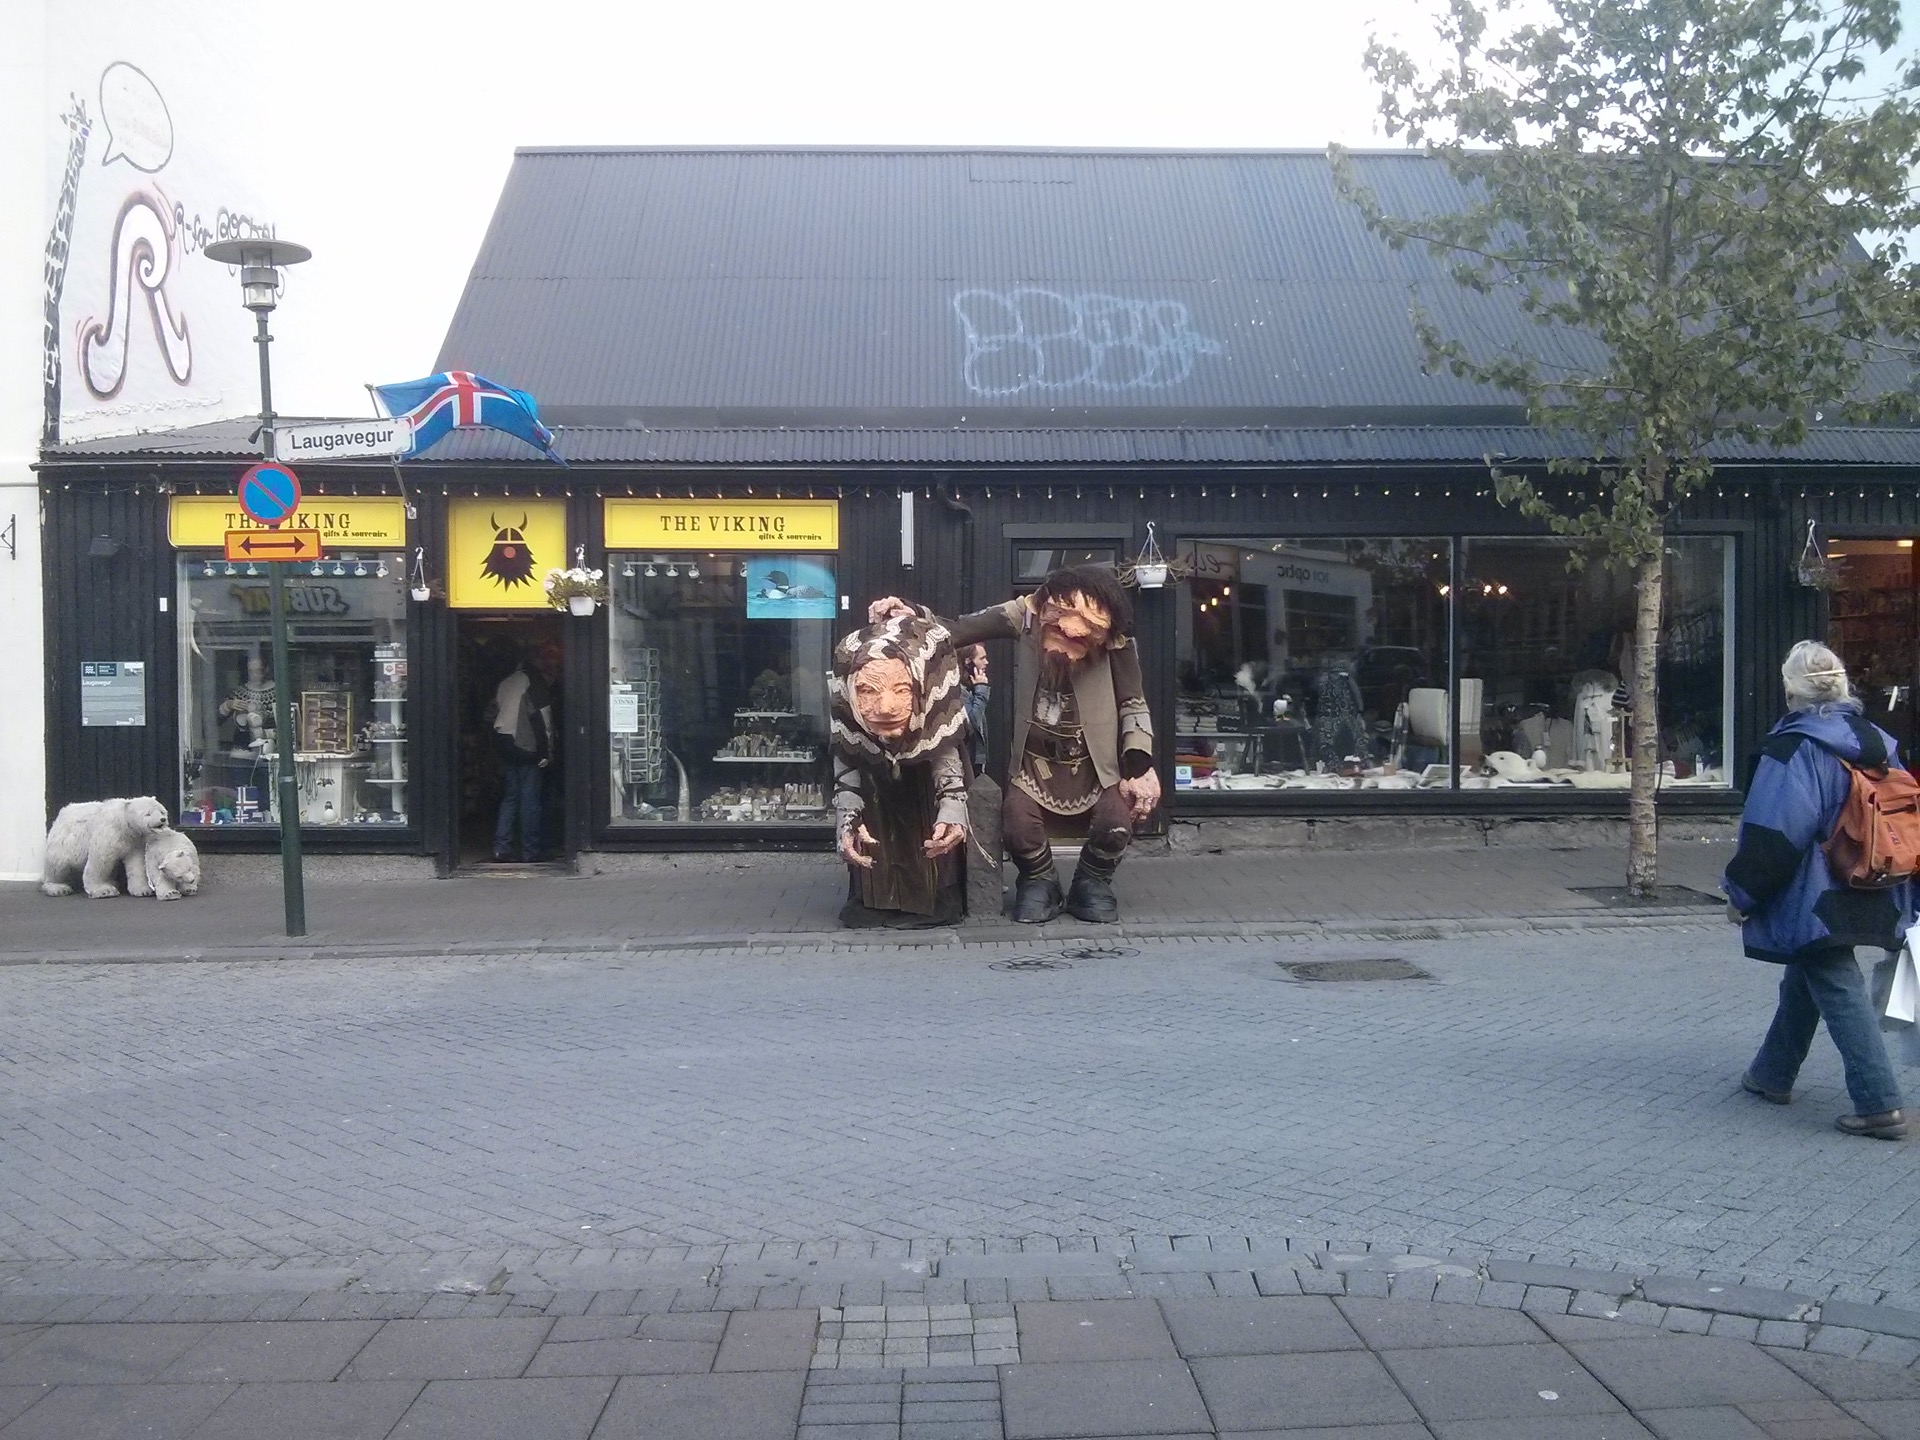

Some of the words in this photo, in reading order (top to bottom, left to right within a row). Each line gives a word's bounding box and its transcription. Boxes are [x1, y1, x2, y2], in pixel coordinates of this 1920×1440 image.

[291, 430, 394, 451] Laugavegur
[286, 513, 351, 529] IKING
[660, 515, 700, 531] THE
[708, 516, 786, 532] VIKING
[323, 530, 340, 538] gifts
[342, 530, 349, 538] &
[758, 533, 775, 541] gifts
